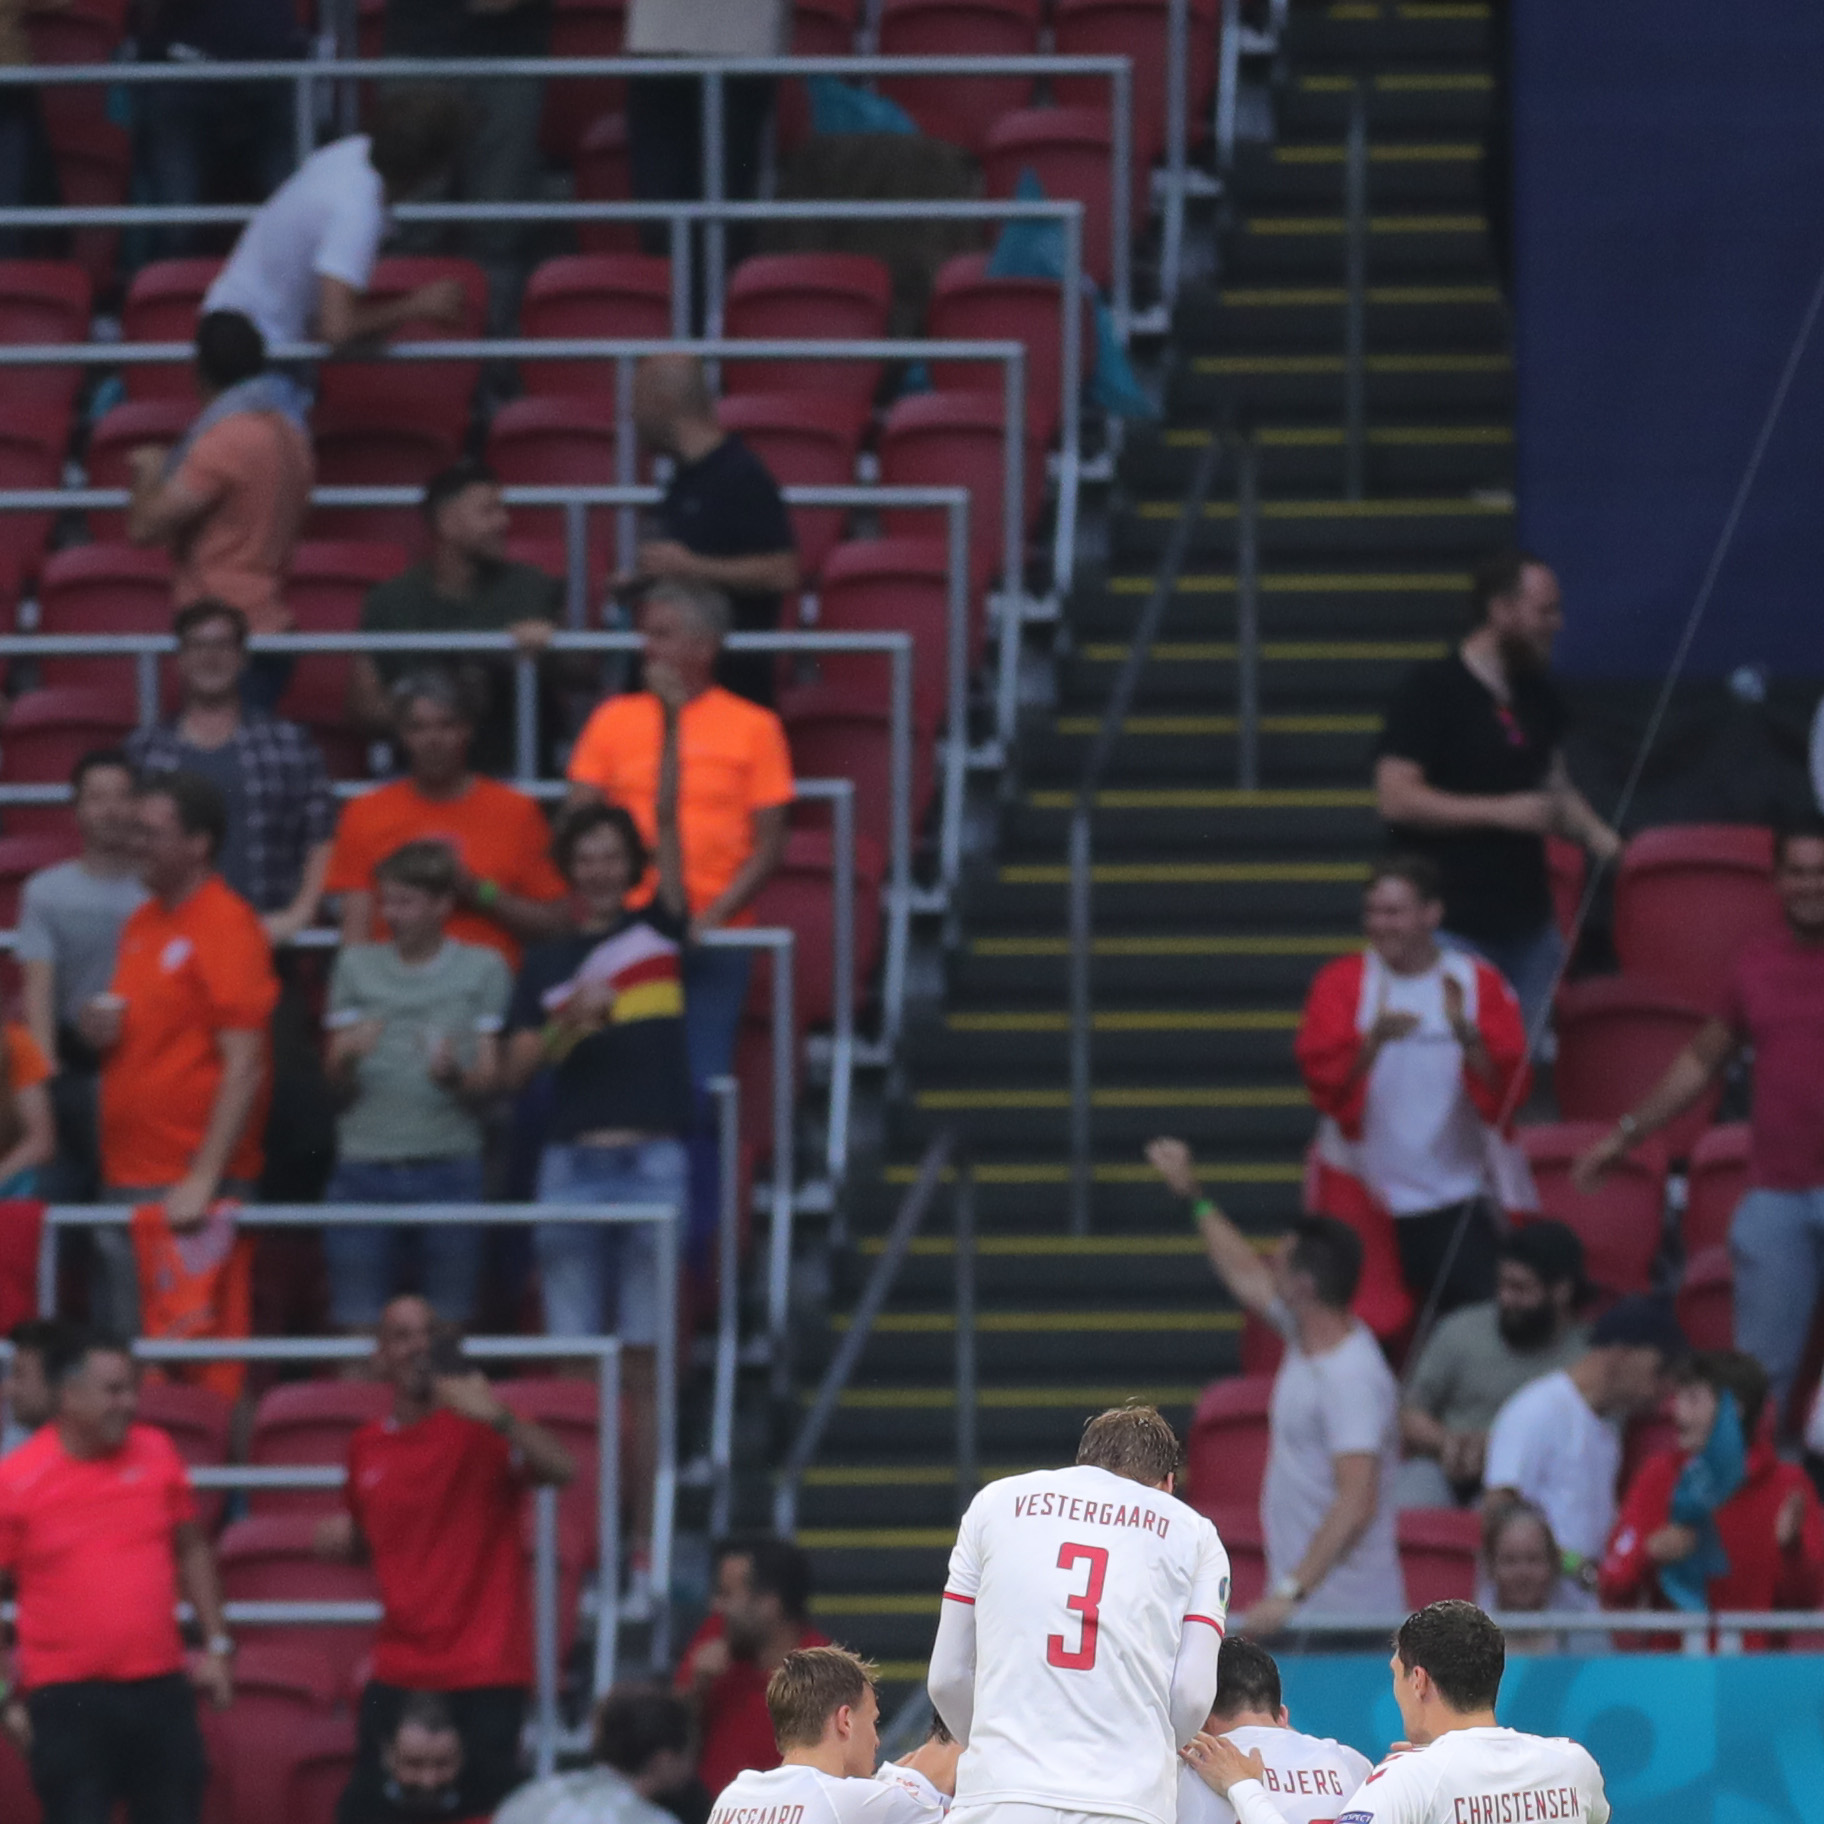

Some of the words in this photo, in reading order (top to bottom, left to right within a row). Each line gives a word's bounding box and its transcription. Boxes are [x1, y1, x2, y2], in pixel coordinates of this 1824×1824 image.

[1014, 1492, 1171, 1540] VESTERGAARD
[1046, 1541, 1110, 1672] 3
[1266, 1767, 1344, 1797] BJERG
